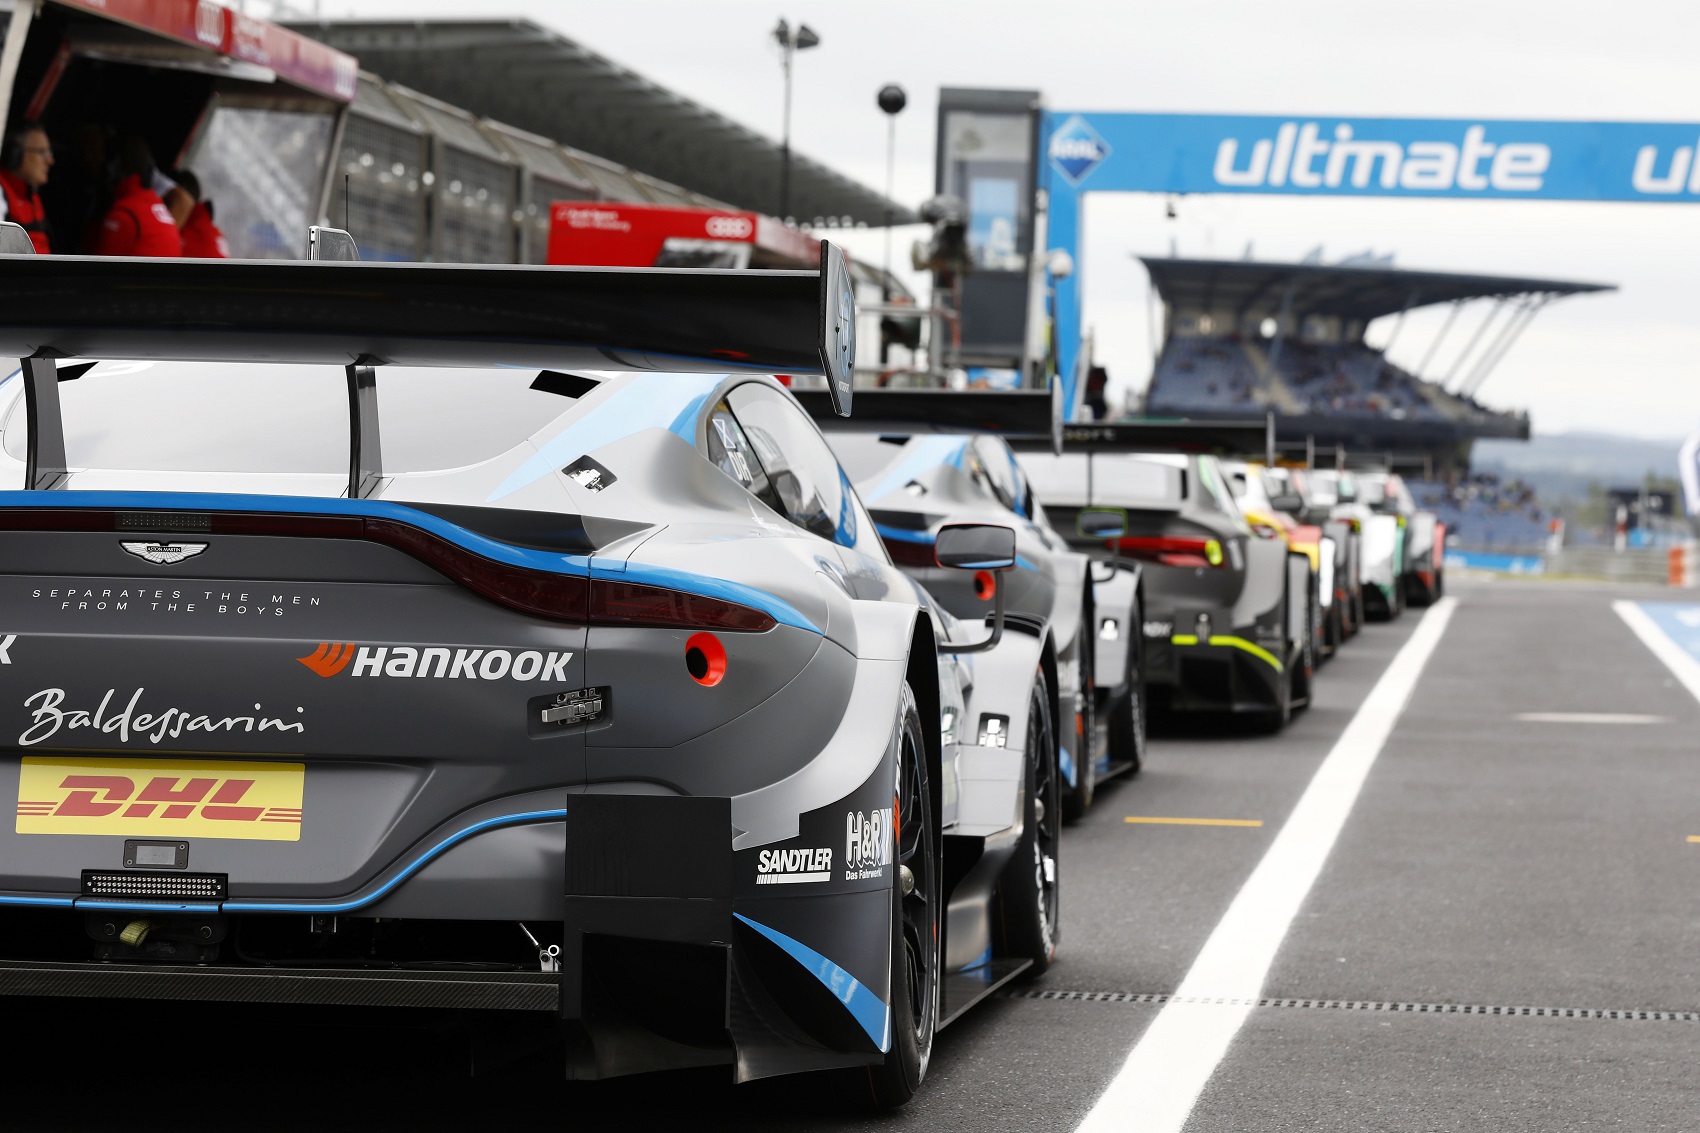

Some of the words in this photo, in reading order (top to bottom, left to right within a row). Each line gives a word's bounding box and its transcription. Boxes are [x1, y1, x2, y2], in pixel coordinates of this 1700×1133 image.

[1213, 121, 1552, 191] ultimate
[32, 589, 181, 599] SEPARATES
[204, 591, 249, 602] THE
[271, 594, 320, 606] MEN
[61, 601, 128, 611] FROM
[150, 602, 195, 612] THE
[218, 604, 284, 616] BOYS
[18, 687, 305, 746] Baldessarini
[52, 775, 266, 822] DHL
[845, 809, 882, 868] H&R
[757, 848, 833, 873] SANDTLER
[845, 869, 858, 881] Das
